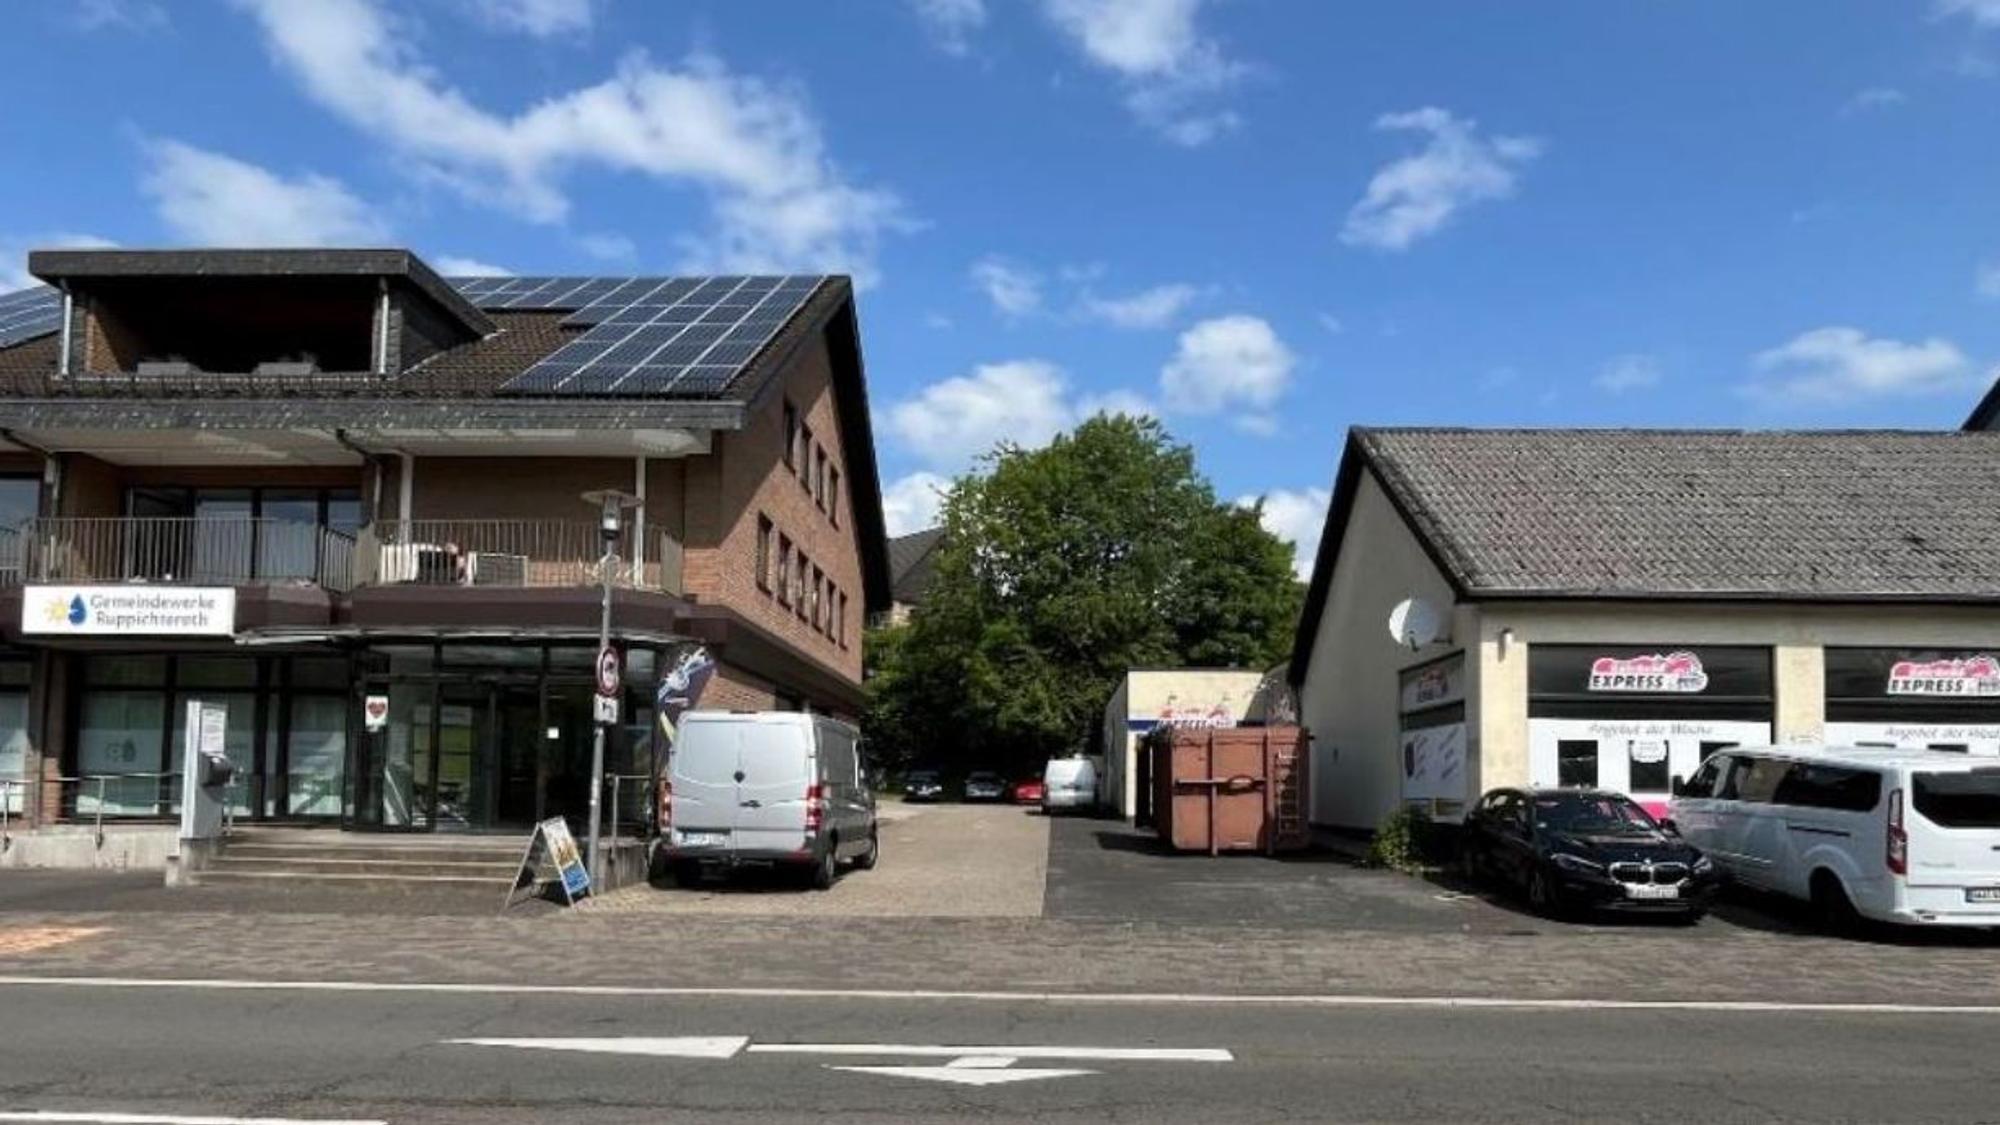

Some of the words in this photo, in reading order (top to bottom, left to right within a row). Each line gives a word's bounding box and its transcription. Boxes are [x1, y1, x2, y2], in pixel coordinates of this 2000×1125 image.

[90, 593, 215, 609] Gemeindewerke
[97, 611, 208, 629] Ruppichteroth
[1592, 675, 1665, 687] EXPRESS
[1891, 679, 1964, 692] EXPRESS
